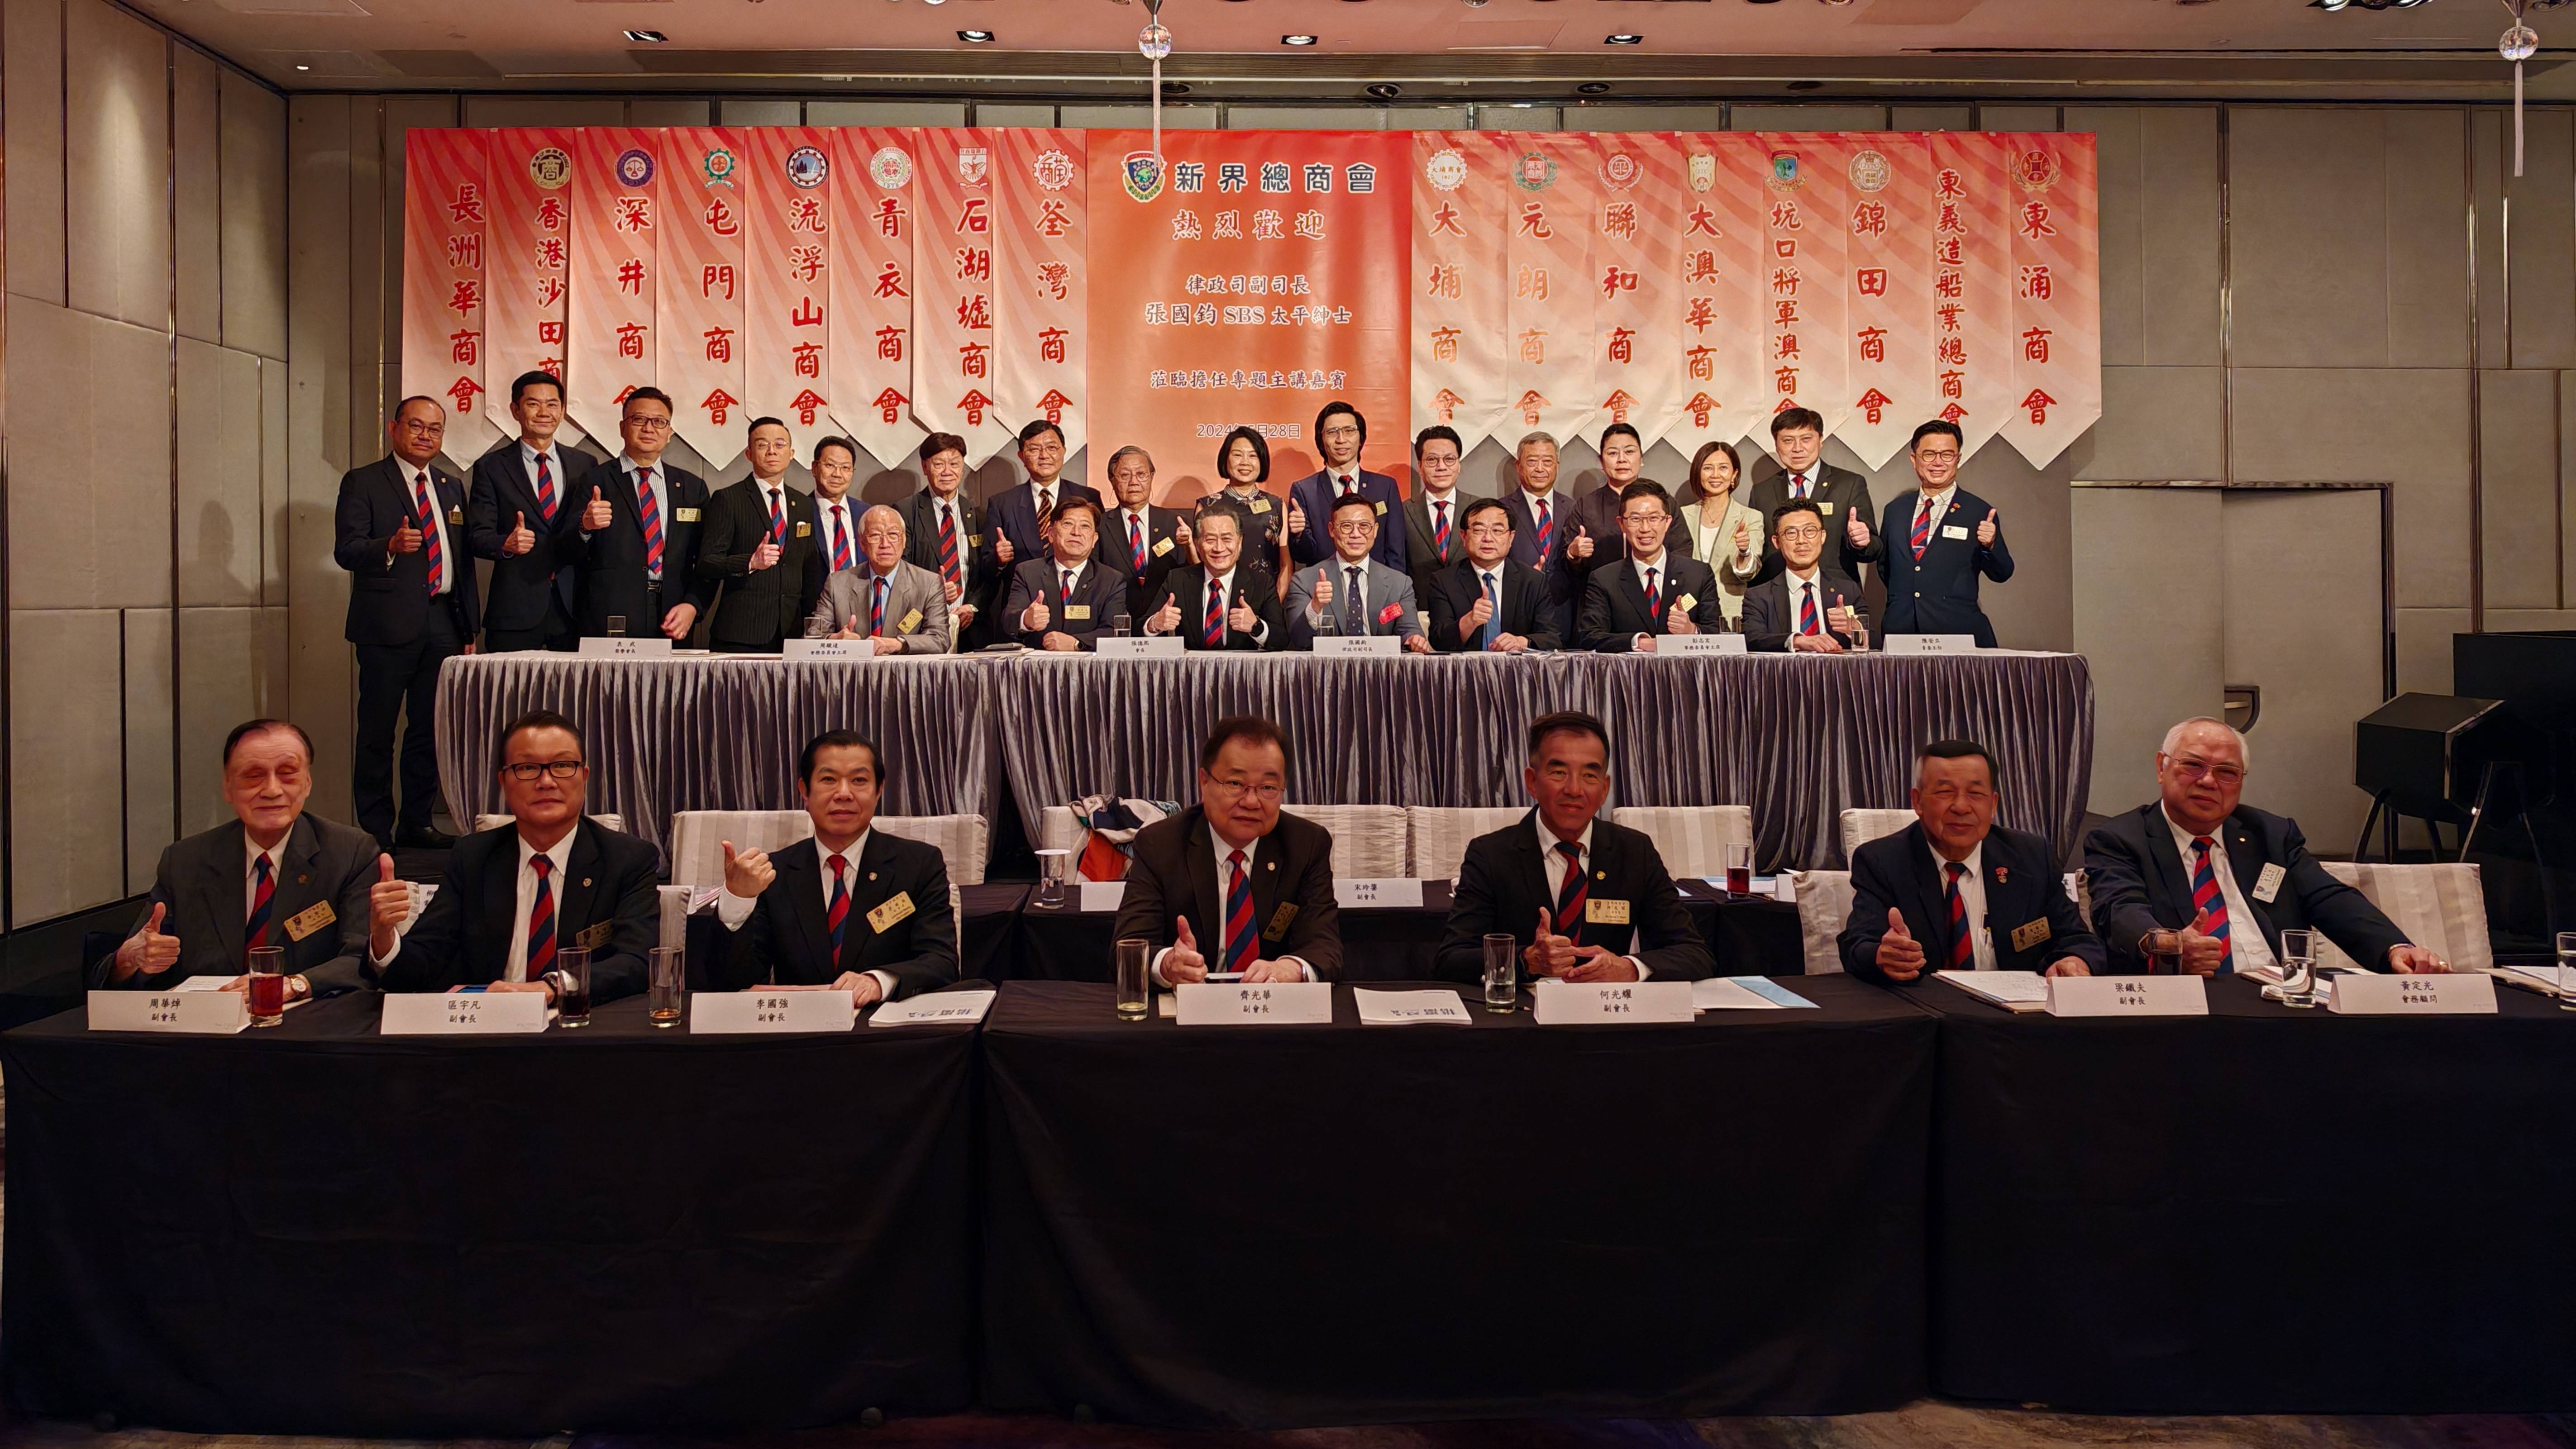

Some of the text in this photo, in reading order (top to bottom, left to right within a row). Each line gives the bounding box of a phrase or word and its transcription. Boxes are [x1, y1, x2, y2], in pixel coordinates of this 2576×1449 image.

[1175, 163, 1376, 193] 新界總商會
[1173, 210, 1326, 240] 熱烈歡迎
[536, 199, 566, 381] 香港沙田商
[1186, 275, 1311, 295] 律政司副司長
[1936, 169, 1969, 424] 東義造船業總商會
[448, 184, 484, 415] 長洲華商會
[701, 198, 739, 426] 屯門商會
[872, 198, 910, 424] 青衣商會
[1035, 200, 1073, 424] 荃灣商會
[790, 198, 827, 427] 流浮山商會
[956, 200, 992, 427] 石湖墟商會
[1145, 303, 1352, 324] 張國鈞 SBS 太平紳士
[1428, 202, 1466, 424] 大埔商會
[1515, 203, 1552, 425] 元朗商會
[1603, 203, 1639, 424] 聯和商會
[1684, 203, 1721, 429] 大澳華商會
[1854, 201, 1892, 425] 錦田商會
[2020, 202, 2057, 425] 東涌商會
[1150, 370, 1347, 389] 蒞臨擔任專題主講嘉賓
[1197, 424, 1300, 439] 2024月28日
[1240, 989, 1272, 1001] 齊光華
[1599, 989, 1633, 1000] 何光耀
[2400, 981, 2434, 991] 黃定光
[148, 998, 181, 1010] 周華焯
[448, 1000, 481, 1010] 區宇凡
[756, 998, 789, 1010] 李國強
[1243, 1004, 1270, 1015] 副會長
[1603, 1003, 1631, 1013] 副會長
[2119, 996, 2146, 1006] 副會長
[151, 1011, 178, 1022] 副會長
[449, 1014, 477, 1024] 副會長
[758, 1013, 786, 1023] 副會長
